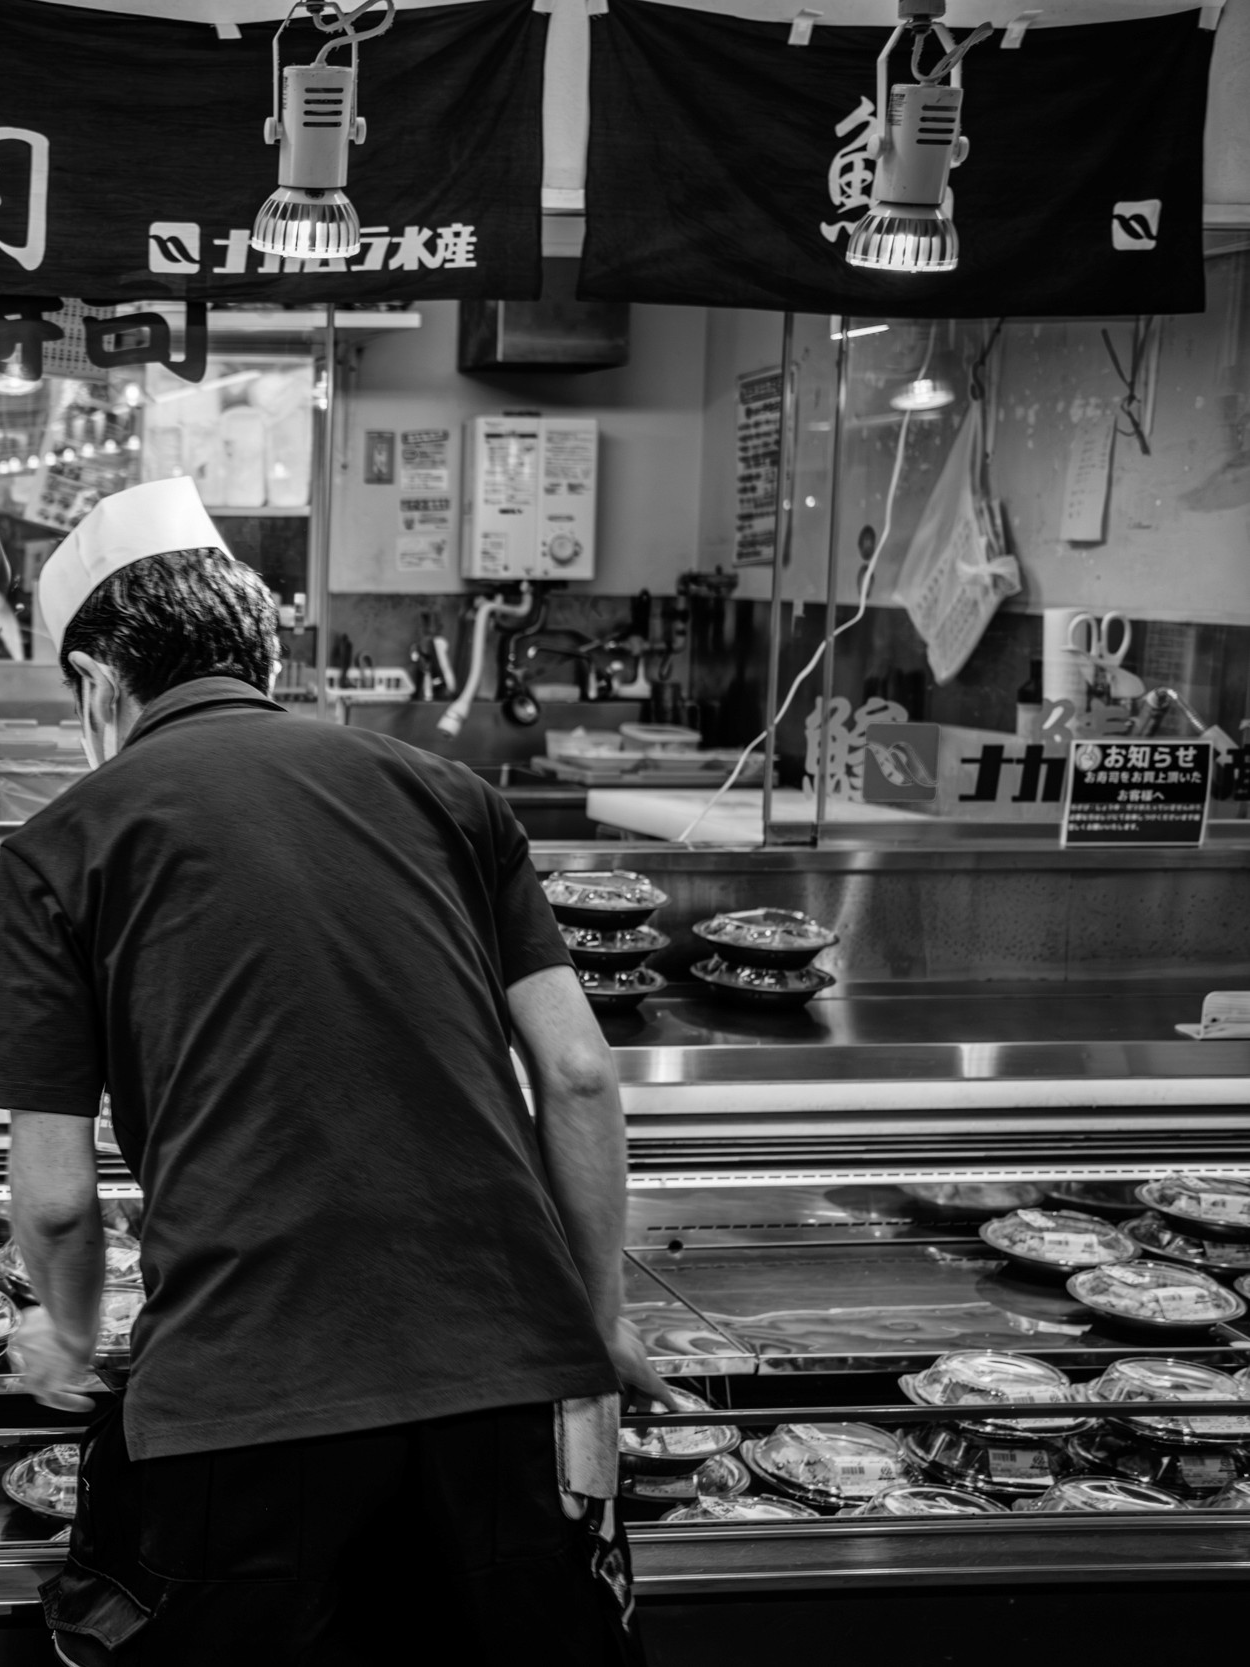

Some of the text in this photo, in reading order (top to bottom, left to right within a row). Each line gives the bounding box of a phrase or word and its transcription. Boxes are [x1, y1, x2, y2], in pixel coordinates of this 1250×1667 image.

[213, 223, 478, 274] ナラ水産
[1104, 746, 1197, 769] お知らせ
[1084, 771, 1202, 784] お寿司をお買上頂いた
[1117, 789, 1165, 802] お客様へ
